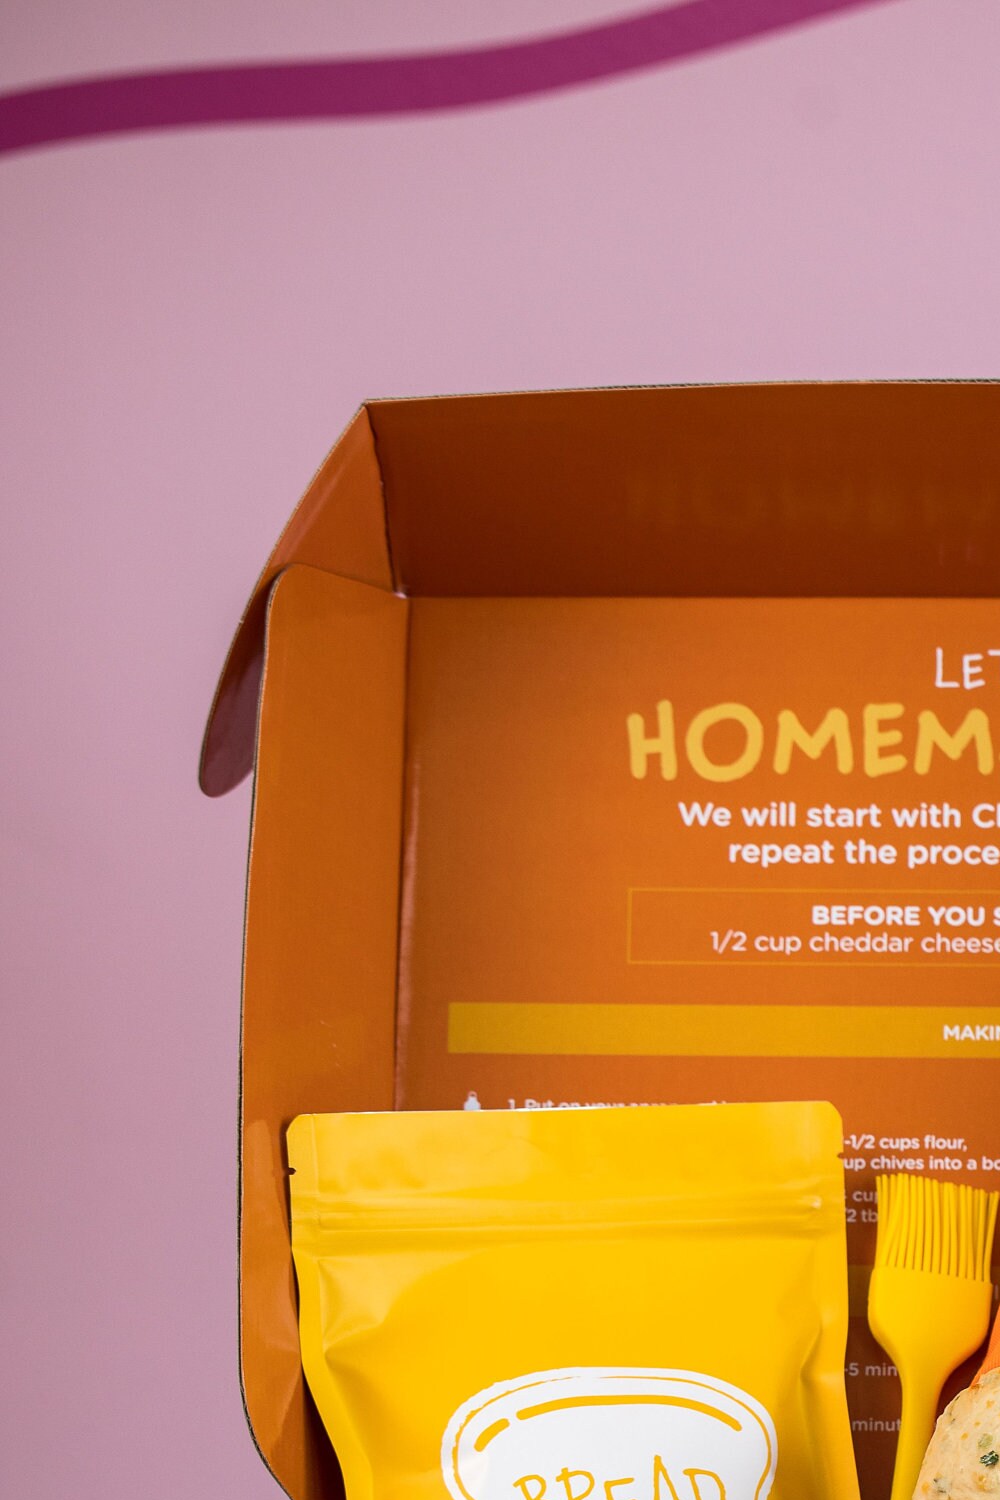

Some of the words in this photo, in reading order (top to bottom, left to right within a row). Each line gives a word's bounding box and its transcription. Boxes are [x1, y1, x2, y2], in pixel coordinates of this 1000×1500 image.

[678, 801, 732, 827] We
[741, 801, 796, 827] will
[806, 803, 882, 828] start
[891, 802, 961, 829] with
[728, 840, 834, 868] repeat
[844, 838, 897, 865] the
[811, 904, 921, 926] BEFORE
[927, 905, 986, 927] YOU
[710, 929, 747, 954] 1/2
[753, 935, 802, 956] cup
[808, 931, 914, 953] cheddar
[843, 1134, 876, 1150] -1/2
[879, 1138, 920, 1151] cups
[924, 1135, 968, 1152] flour,
[843, 1157, 867, 1171] up
[870, 1155, 924, 1170] chives
[929, 1156, 963, 1171] into
[966, 1160, 978, 1171] a
